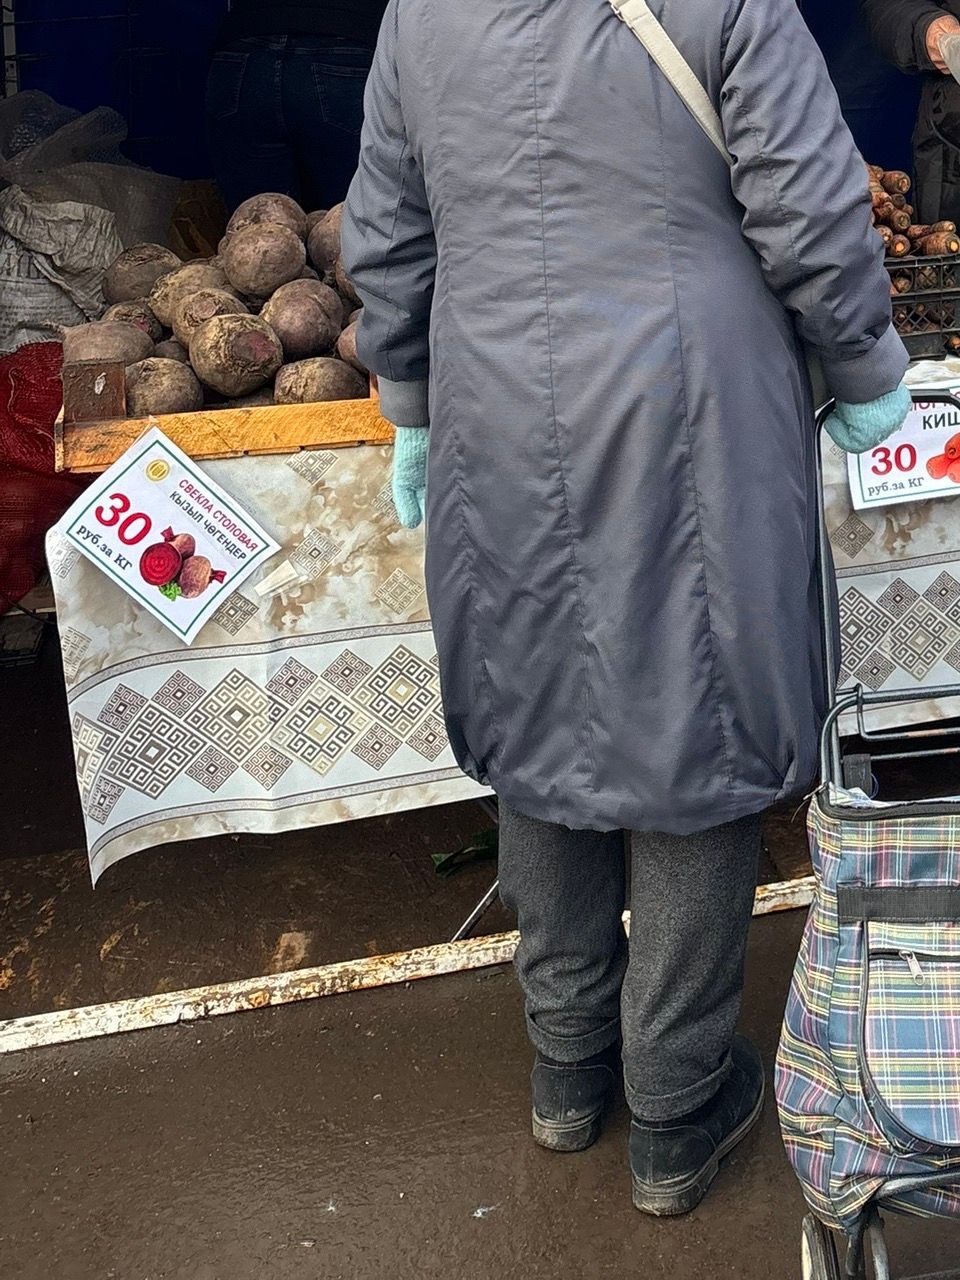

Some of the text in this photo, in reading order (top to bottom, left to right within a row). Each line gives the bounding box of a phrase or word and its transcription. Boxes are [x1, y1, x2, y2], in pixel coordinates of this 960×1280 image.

[871, 443, 918, 476] 30
[908, 477, 925, 488] КГ
[95, 492, 152, 546] 30
[169, 490, 204, 524] КЫЗЫЛ
[178, 478, 259, 552] СВЕКЛА СТОЛОВАЯ
[76, 525, 133, 571] руб.за КГ
